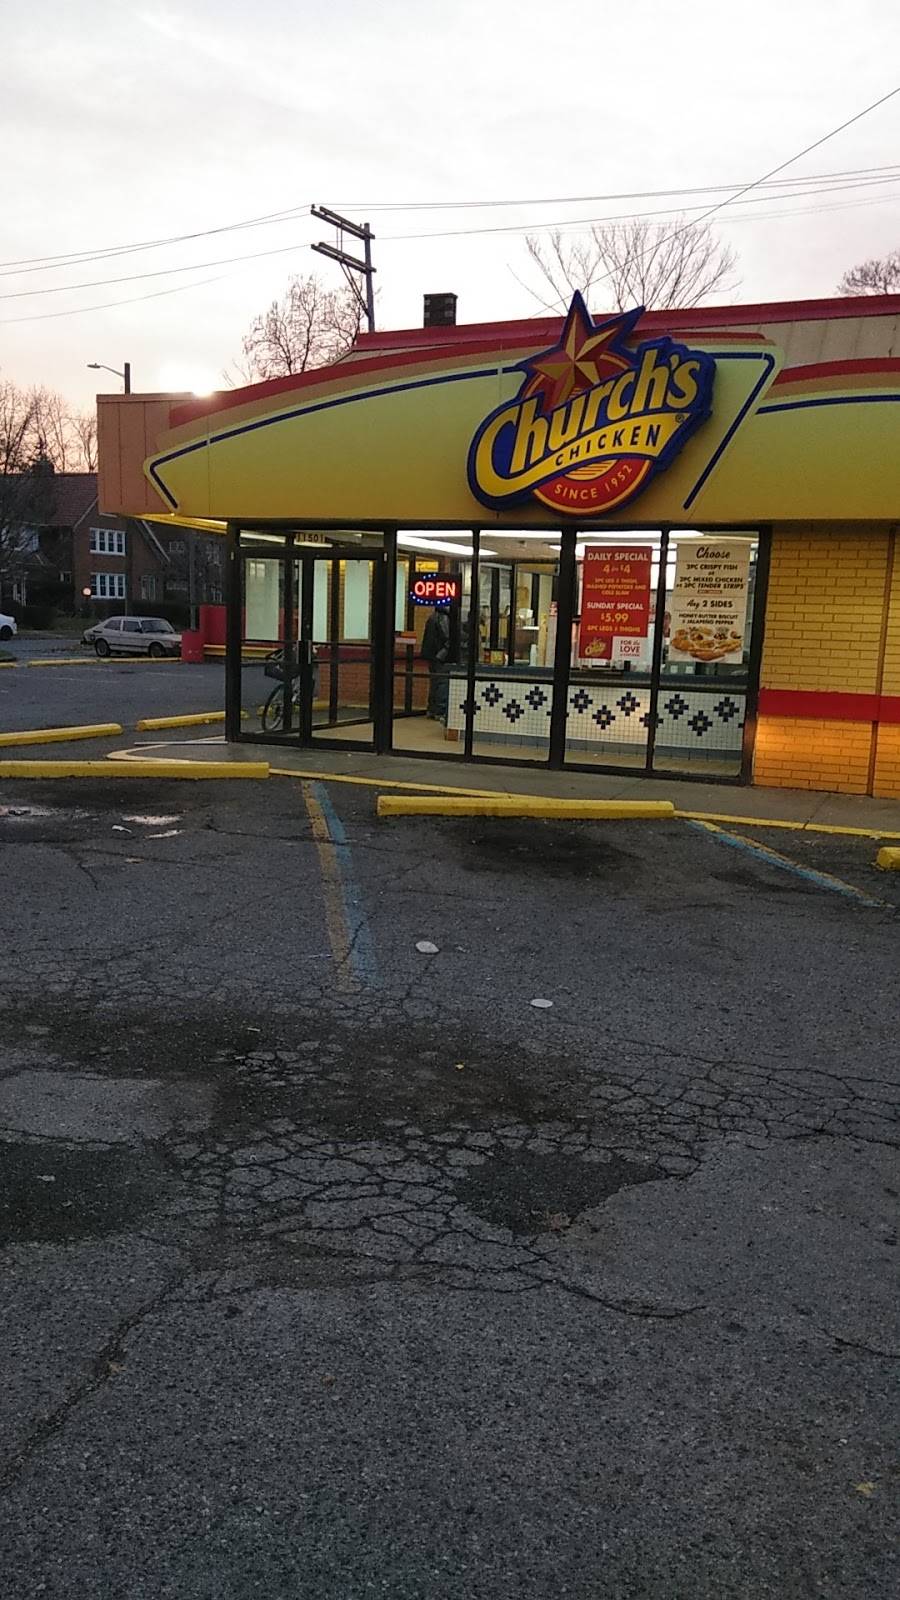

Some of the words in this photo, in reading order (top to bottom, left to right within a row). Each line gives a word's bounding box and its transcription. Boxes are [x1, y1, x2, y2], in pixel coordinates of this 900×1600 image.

[475, 349, 700, 497] Church's
[555, 424, 661, 466] CHICKEN
[555, 484, 598, 500] SINCE
[604, 465, 632, 492] 1952
[588, 552, 612, 561] DAILY
[614, 552, 648, 561] SPECIAL
[696, 546, 731, 559] Choose
[603, 564, 610, 573] 4
[414, 581, 456, 597] OPEN
[587, 601, 615, 609] SUNDAY
[616, 602, 644, 610] SPECIAL
[687, 599, 700, 609] Any
[710, 600, 733, 608] SIDES
[601, 612, 629, 623] $5.99
[620, 645, 640, 653] LOVE
